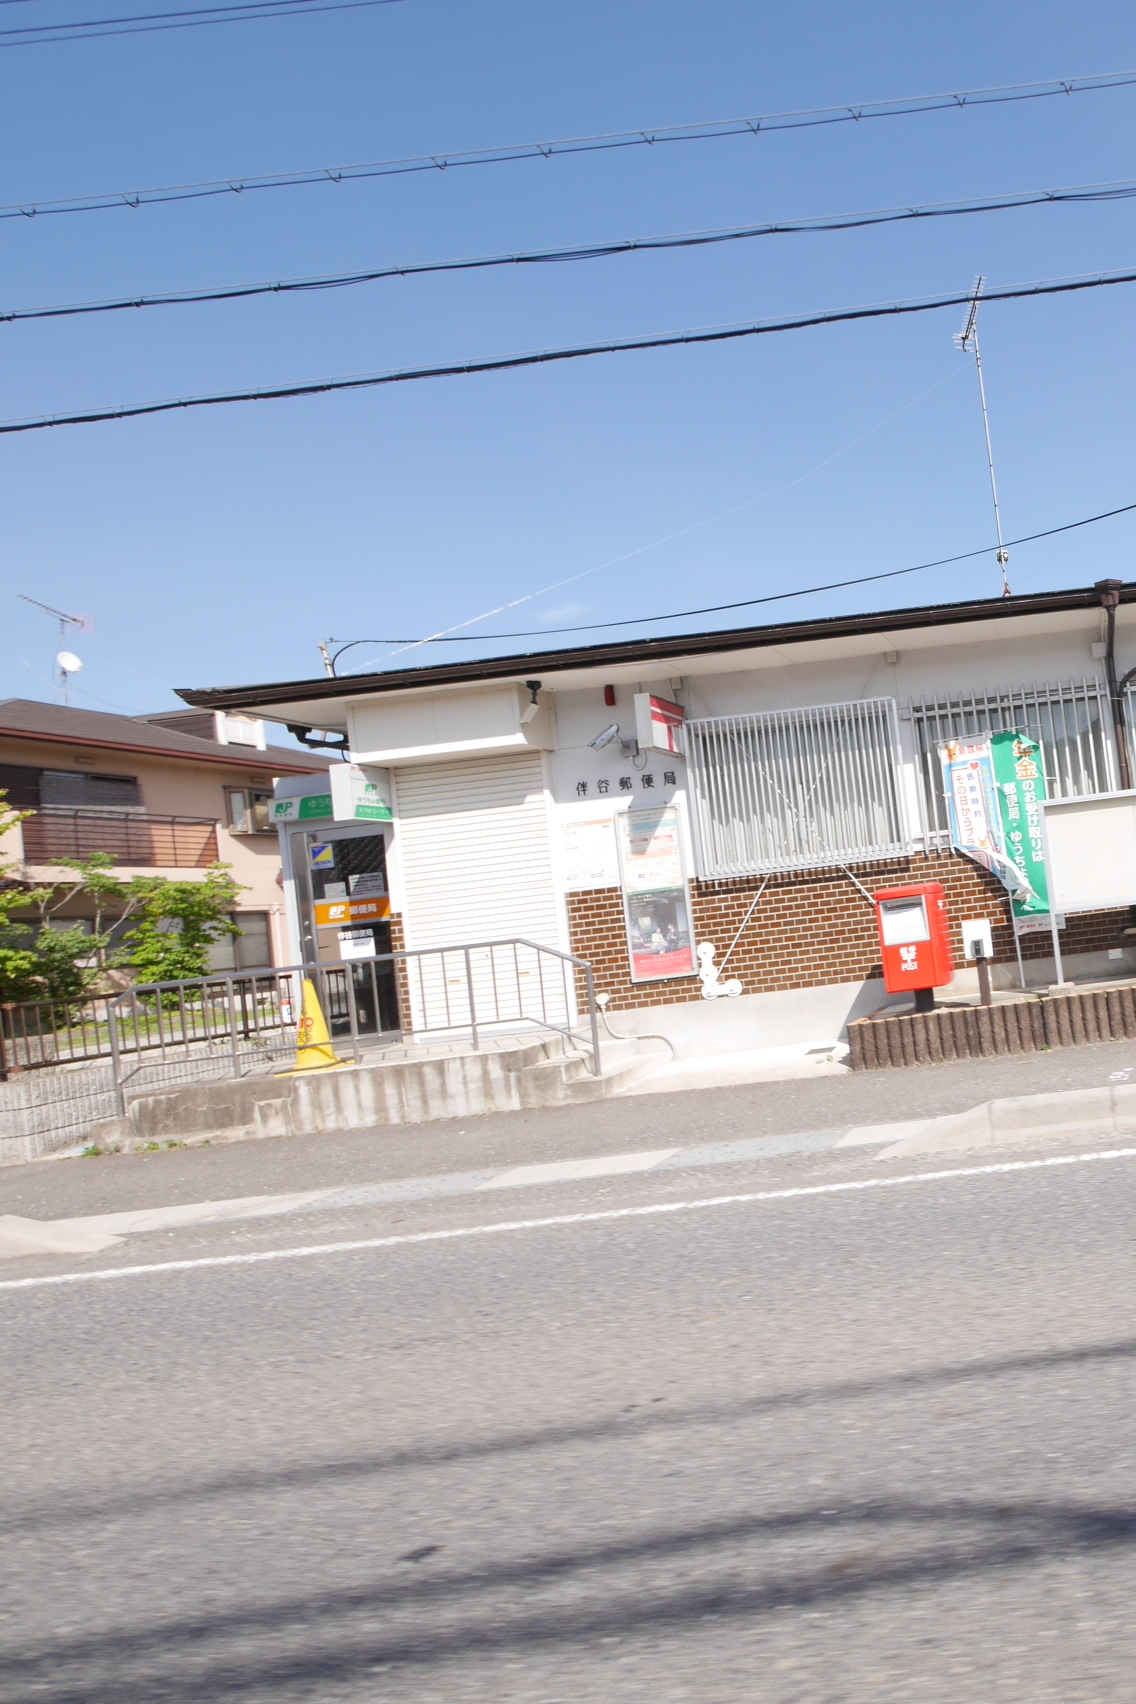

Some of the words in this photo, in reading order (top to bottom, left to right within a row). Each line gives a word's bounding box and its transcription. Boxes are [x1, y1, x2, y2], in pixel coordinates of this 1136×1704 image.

[576, 771, 677, 796] 伴谷郵便局
[349, 903, 377, 915] 郵便局
[901, 961, 919, 971] POST
